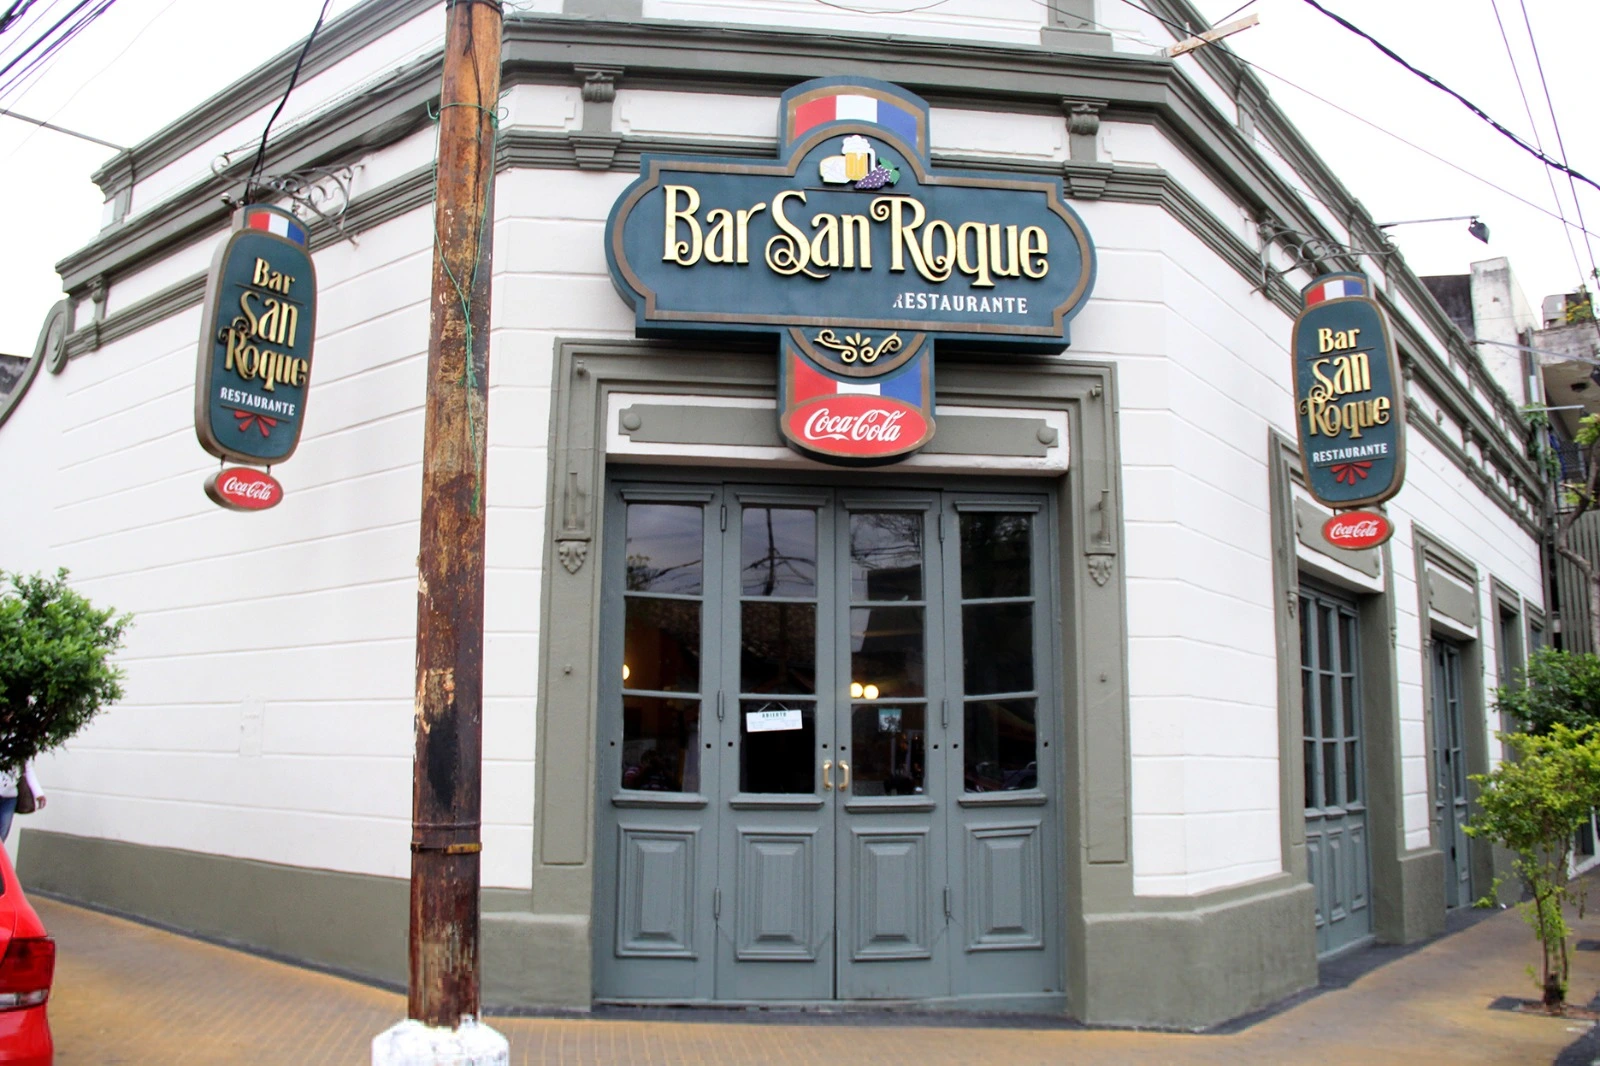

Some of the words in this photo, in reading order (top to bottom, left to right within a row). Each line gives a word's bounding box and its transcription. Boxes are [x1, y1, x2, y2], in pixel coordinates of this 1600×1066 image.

[662, 184, 767, 267] Bar
[765, 189, 873, 279] San
[870, 196, 1049, 287] Roque
[252, 257, 295, 295] Bar
[232, 290, 298, 348] San
[218, 327, 309, 391] Roque
[1317, 327, 1360, 354] Bar
[1308, 352, 1371, 402] San
[220, 387, 296, 416] RESTAURANTE
[1299, 396, 1390, 439] Roque
[804, 408, 905, 442] Coca-Cola
[1312, 442, 1388, 463] RESTAURANTE
